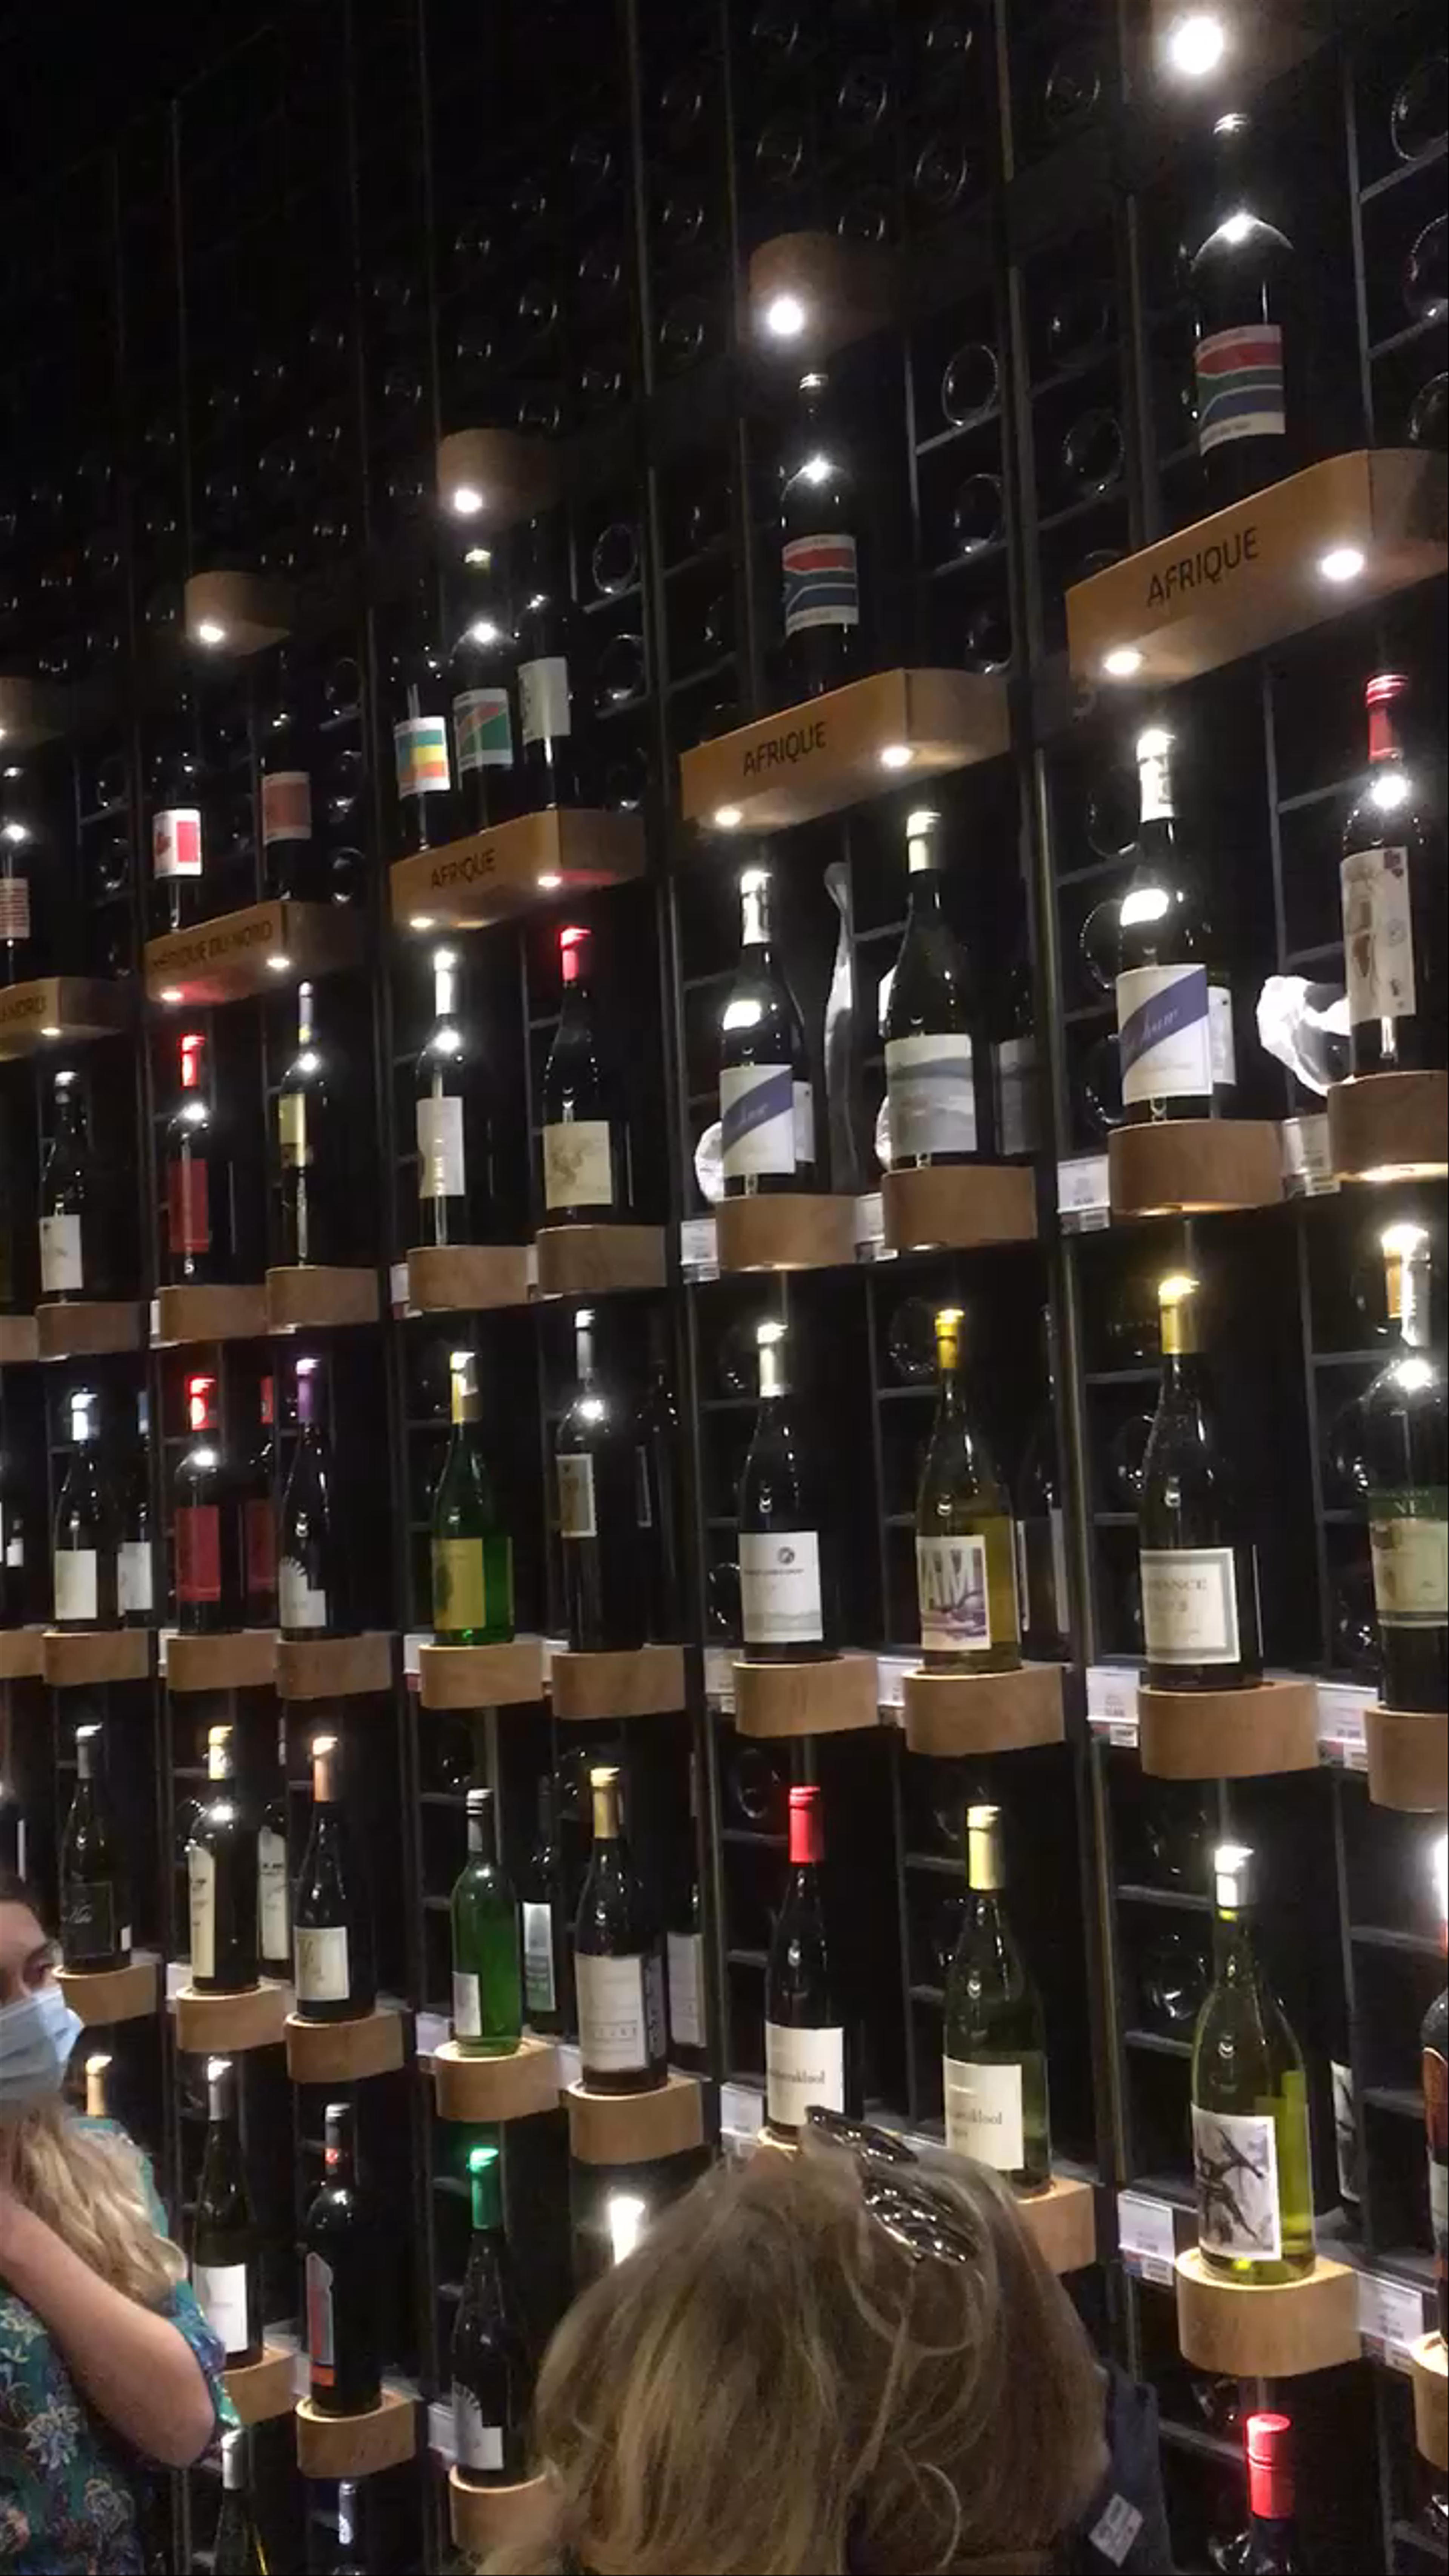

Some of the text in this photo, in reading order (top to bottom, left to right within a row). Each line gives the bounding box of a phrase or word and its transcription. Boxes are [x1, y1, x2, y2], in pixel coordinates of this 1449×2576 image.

[1147, 528, 1260, 607] AFRIQUE
[743, 721, 826, 777] AFRIQUE
[431, 848, 495, 890] AFRIQUE
